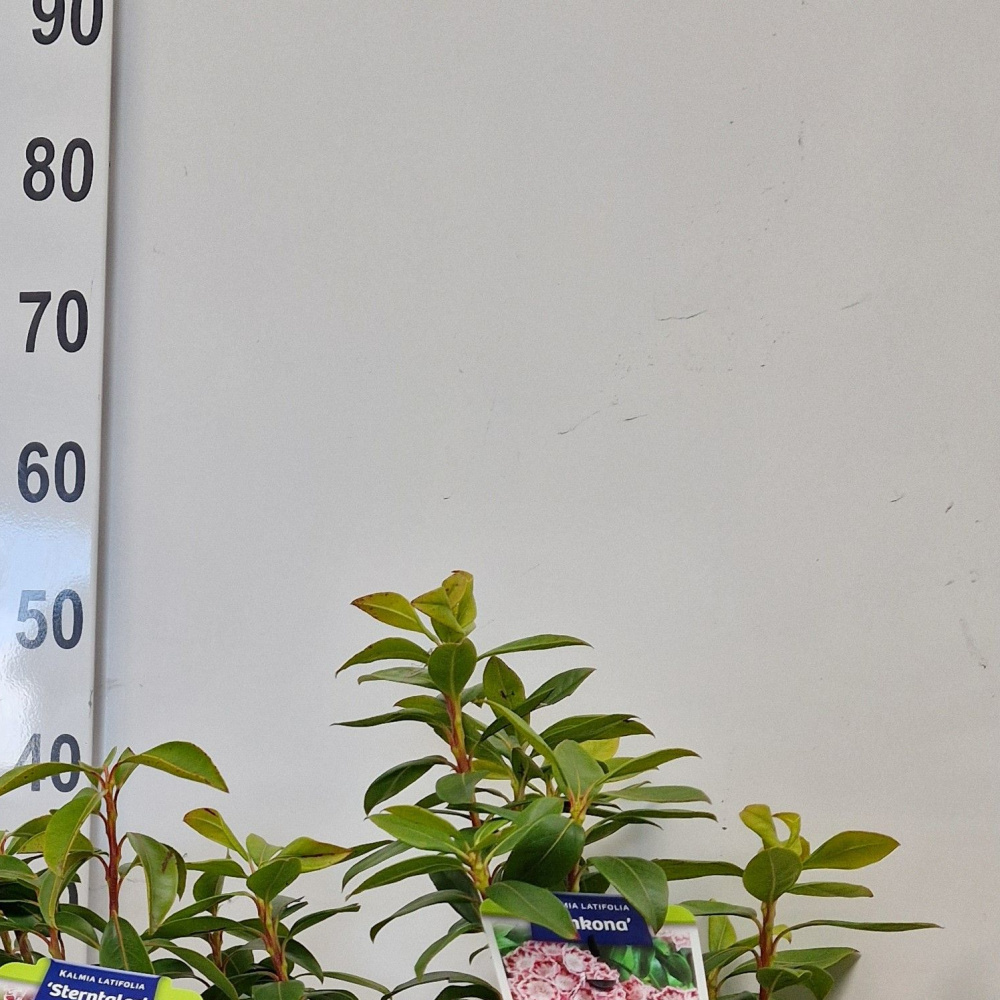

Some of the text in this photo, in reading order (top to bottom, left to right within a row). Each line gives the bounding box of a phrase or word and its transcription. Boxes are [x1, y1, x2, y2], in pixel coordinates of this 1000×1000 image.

[32, 0, 103, 46] 90
[23, 137, 94, 202] 80
[19, 289, 89, 353] 70
[17, 441, 86, 503] 60
[15, 589, 83, 650] 50
[581, 903, 630, 911] LATIFOLIA
[59, 969, 145, 990] KALMIA LATIFOLIA
